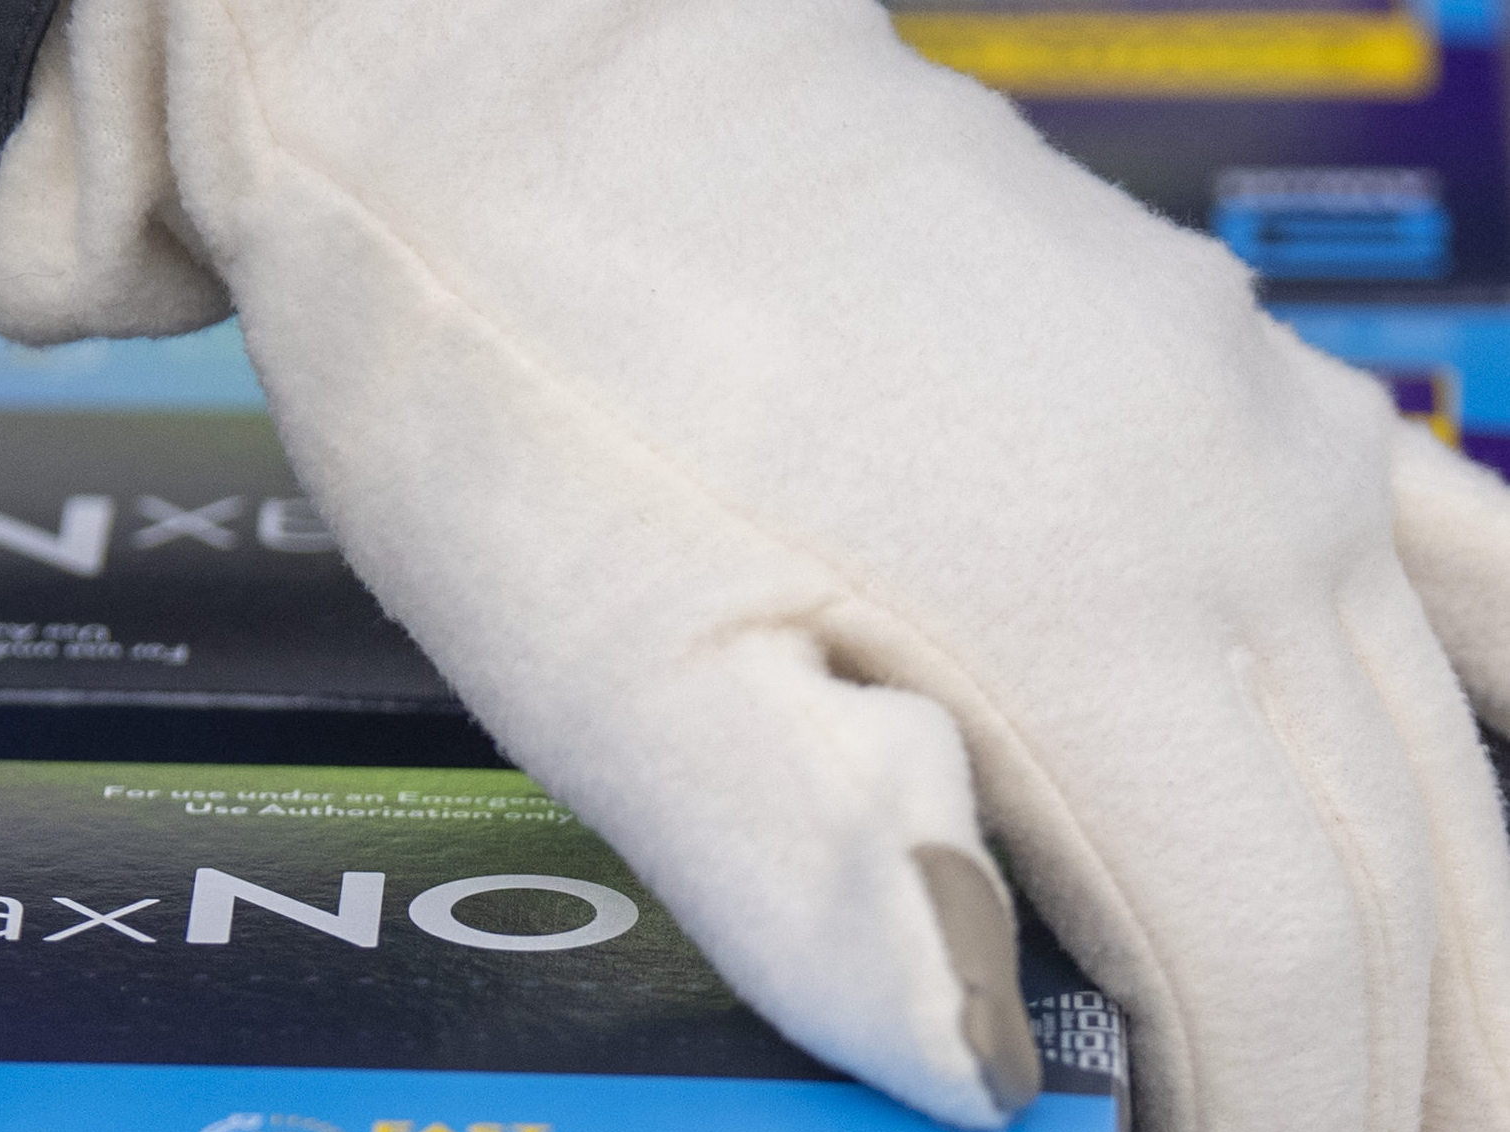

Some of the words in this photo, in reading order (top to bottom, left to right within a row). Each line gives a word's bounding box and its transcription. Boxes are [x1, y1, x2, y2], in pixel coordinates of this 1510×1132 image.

[103, 784, 161, 799] For
[170, 790, 226, 800] use
[237, 789, 334, 801] under
[346, 793, 384, 803] an
[397, 791, 550, 809] Emergen
[185, 801, 248, 816] Use
[257, 803, 493, 820] Authorization
